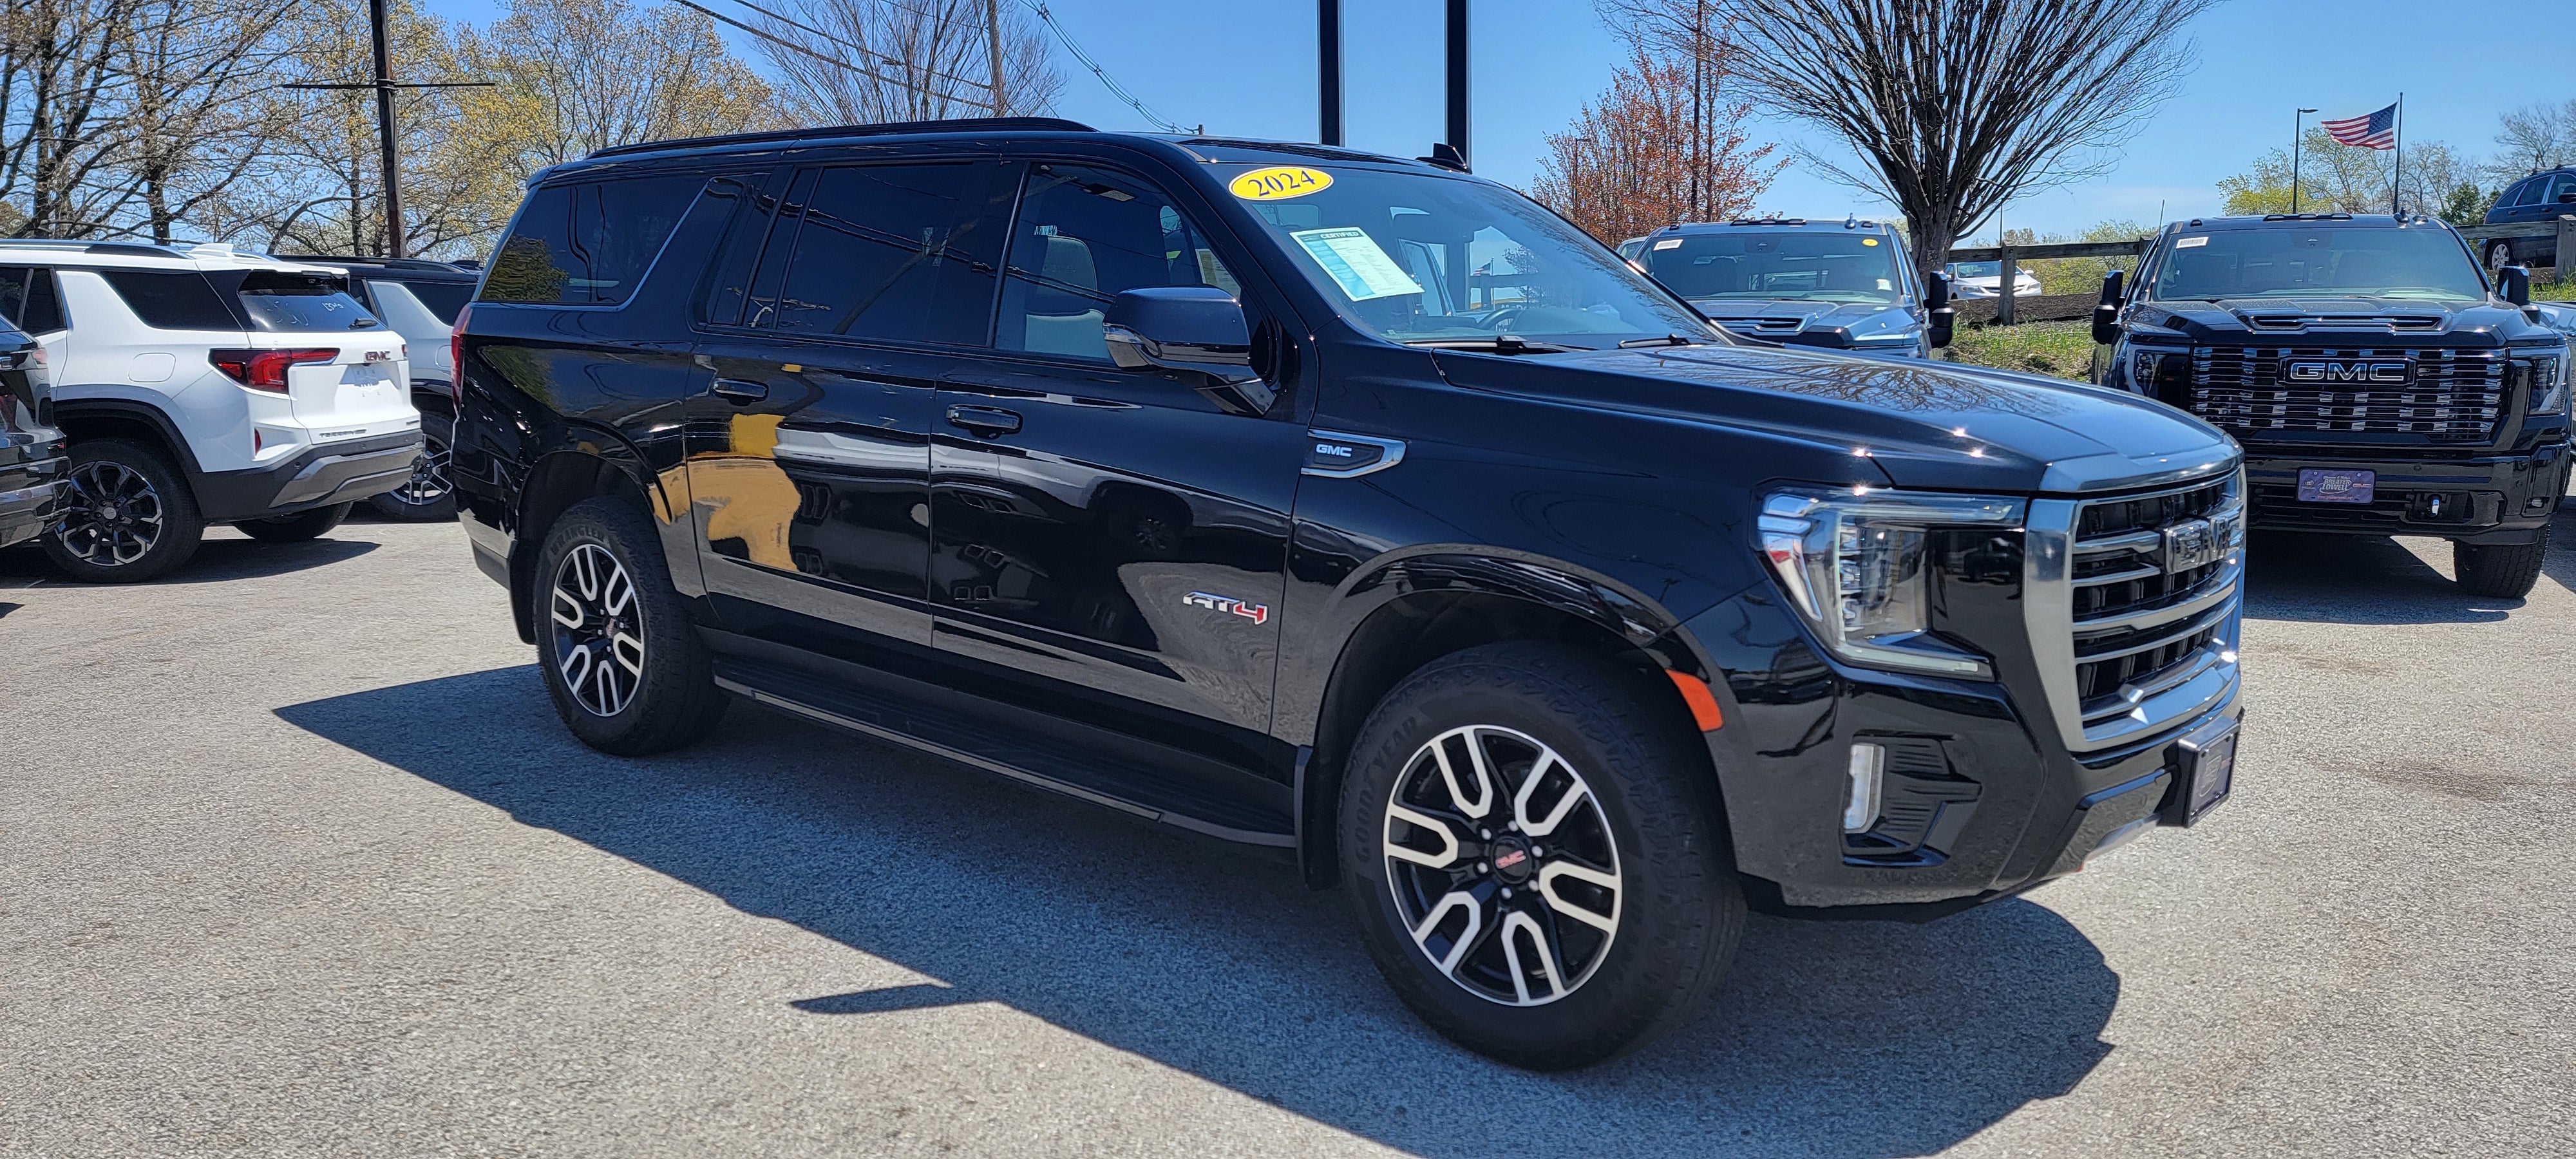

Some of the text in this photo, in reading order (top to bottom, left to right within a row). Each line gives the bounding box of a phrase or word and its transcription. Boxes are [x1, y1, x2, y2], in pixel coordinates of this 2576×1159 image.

[1248, 170, 1316, 197] 2024
[1320, 231, 1359, 240] CERTIFIED
[364, 350, 392, 363] GMC
[2289, 362, 2406, 381] GMC
[1316, 444, 1353, 458] GMC
[1182, 590, 1269, 625] AT4
[1355, 715, 1417, 863] GOODYEAR
[1495, 849, 1527, 869] GMC
